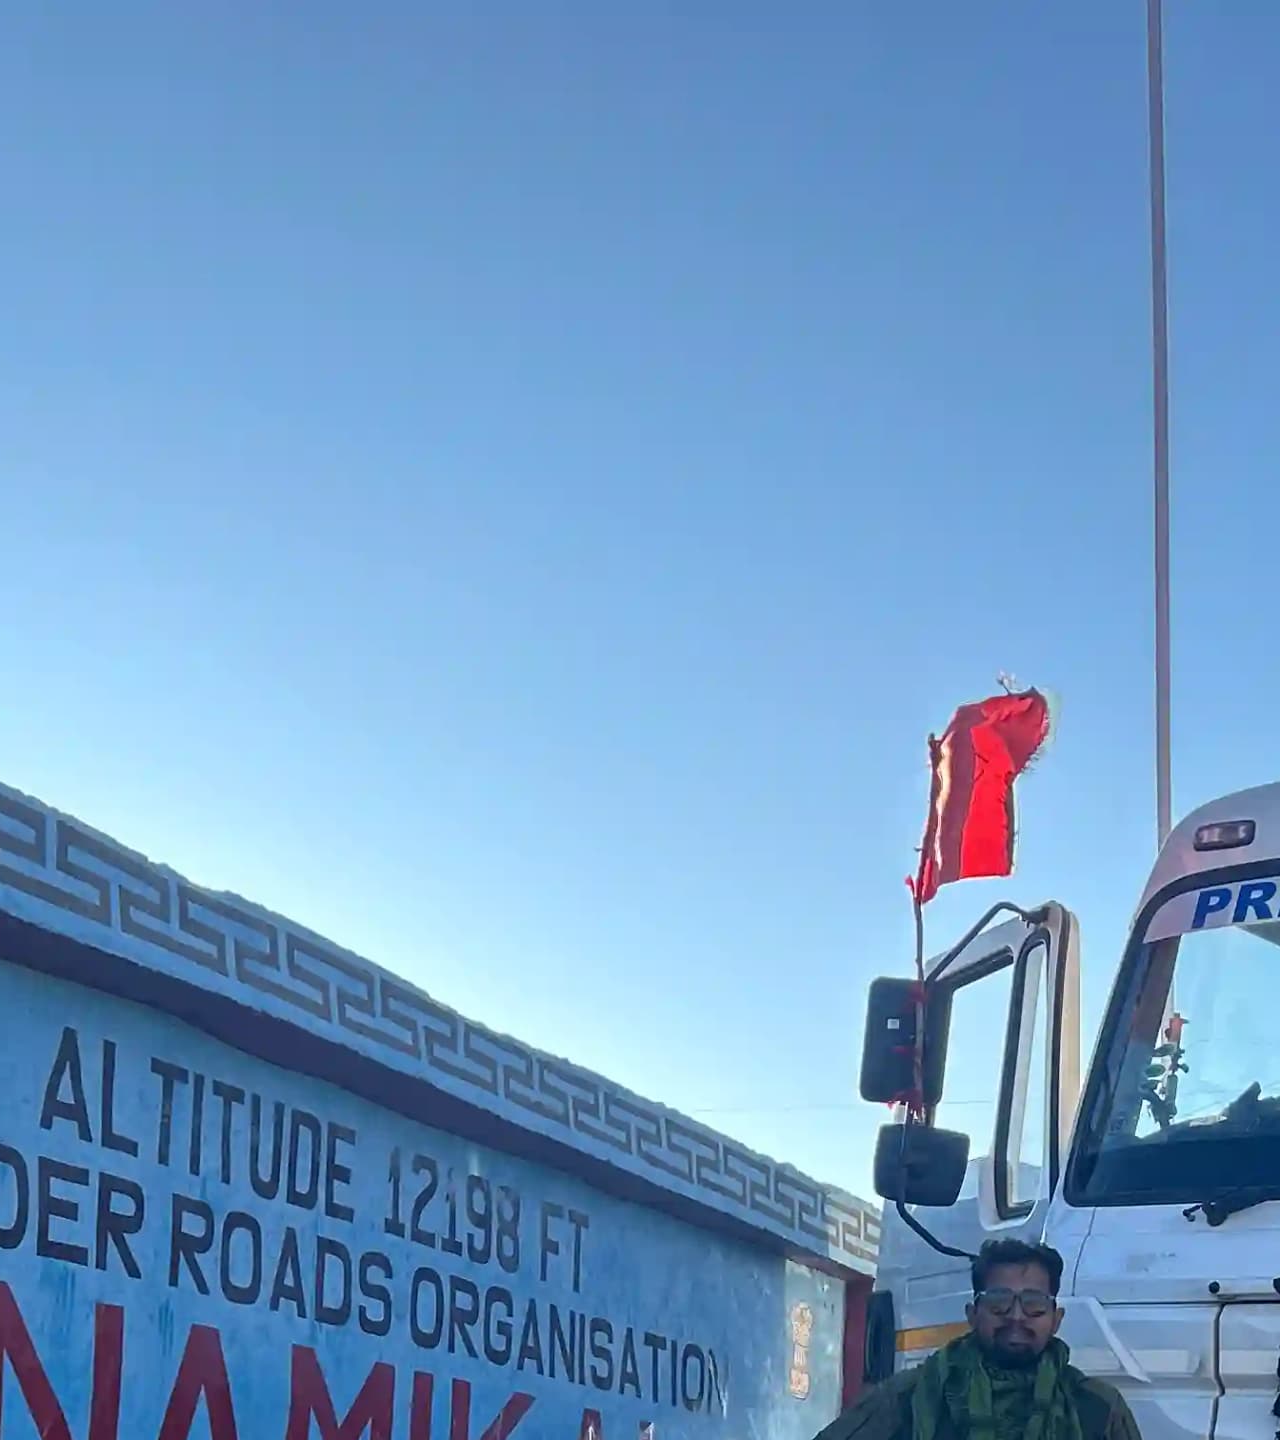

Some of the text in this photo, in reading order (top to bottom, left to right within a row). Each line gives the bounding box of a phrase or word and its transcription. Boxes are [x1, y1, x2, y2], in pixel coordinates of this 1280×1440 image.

[39, 1025, 591, 1294] ALTITUDE 12198 FT
[167, 1191, 395, 1338] ROADS
[409, 1266, 727, 1415] ORGANISATION
